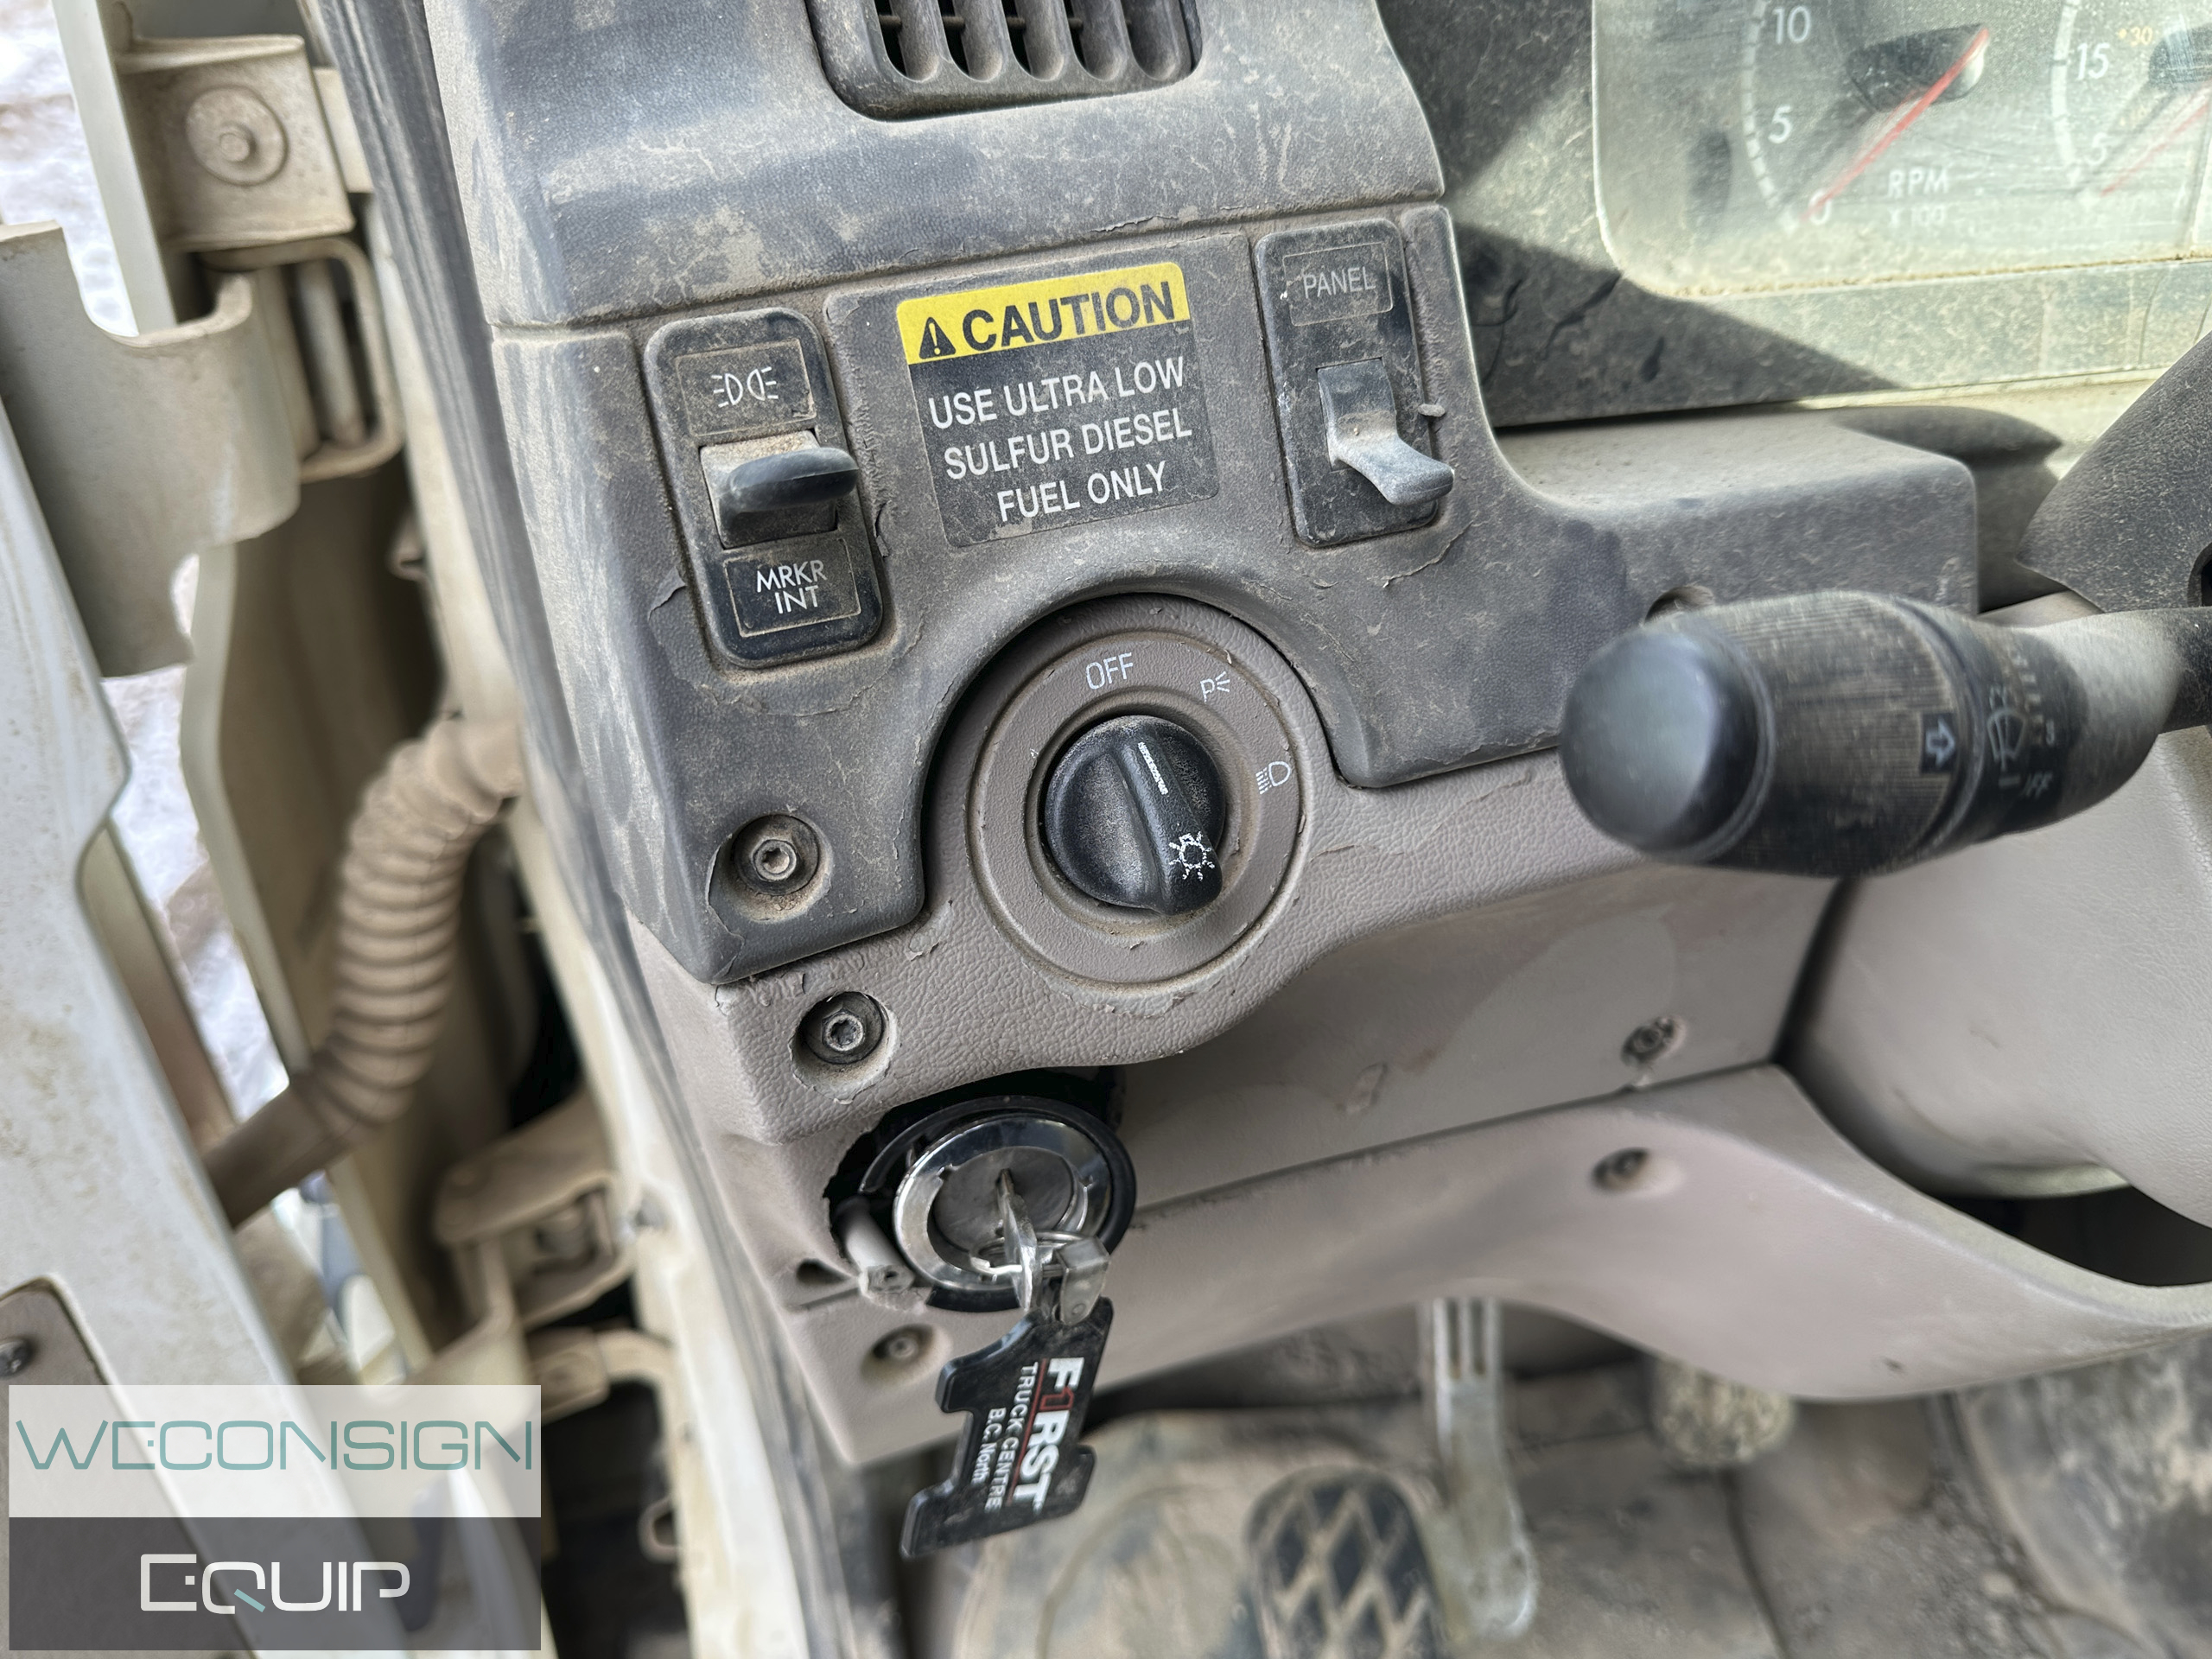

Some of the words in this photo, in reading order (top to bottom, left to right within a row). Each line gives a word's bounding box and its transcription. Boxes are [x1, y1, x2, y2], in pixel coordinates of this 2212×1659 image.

[1771, 5, 1812, 44] 10
[2075, 41, 2111, 80] 15
[1768, 103, 1793, 144] 5
[1886, 166, 1949, 199] RPM
[1808, 188, 1833, 226] 0
[1302, 266, 1376, 299] PANEL
[962, 280, 1176, 352] CAUTION
[928, 388, 998, 430] USE
[1003, 370, 1109, 416] ULTRA
[1114, 355, 1184, 398] LOW
[944, 427, 1075, 480] SULFUR
[1081, 407, 1193, 455] DIESEL
[996, 480, 1081, 522] FUEL
[1087, 460, 1166, 505] ONLY
[757, 560, 827, 593] MRKR
[774, 584, 819, 614] INT
[1084, 652, 1135, 690] OFF
[1005, 1361, 1039, 1436] TRUCK
[982, 1407, 1007, 1442] B.C.
[970, 1441, 997, 1486] North
[984, 1436, 1020, 1513] CENTRE
